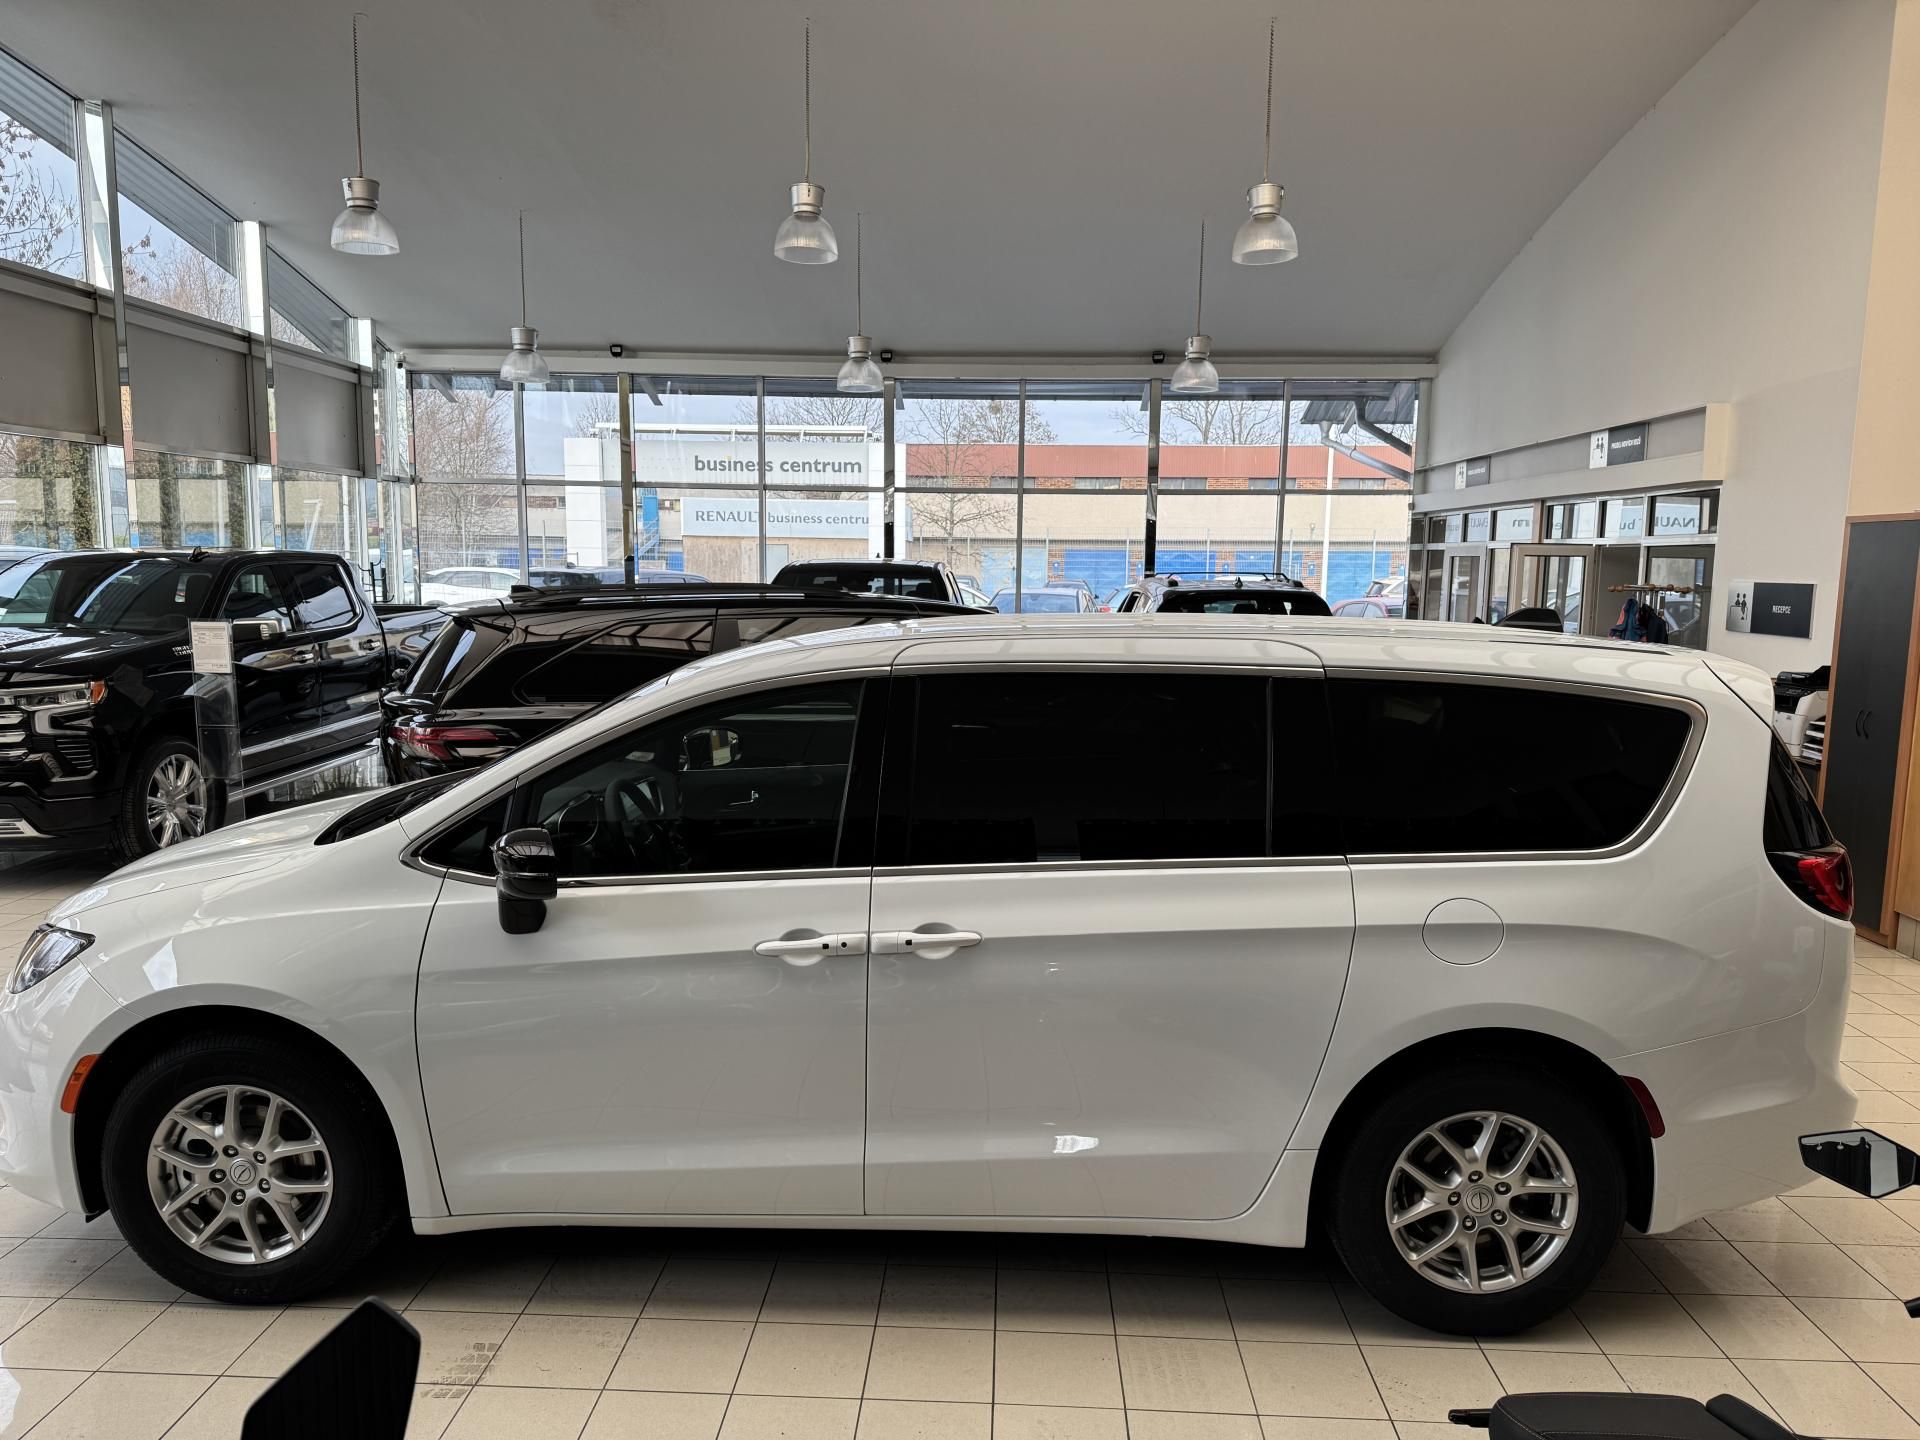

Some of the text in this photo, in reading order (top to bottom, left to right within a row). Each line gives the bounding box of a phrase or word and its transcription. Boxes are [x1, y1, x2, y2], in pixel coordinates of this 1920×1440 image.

[694, 455, 862, 473] busines centrum
[768, 511, 823, 524] business
[825, 514, 869, 525] centru
